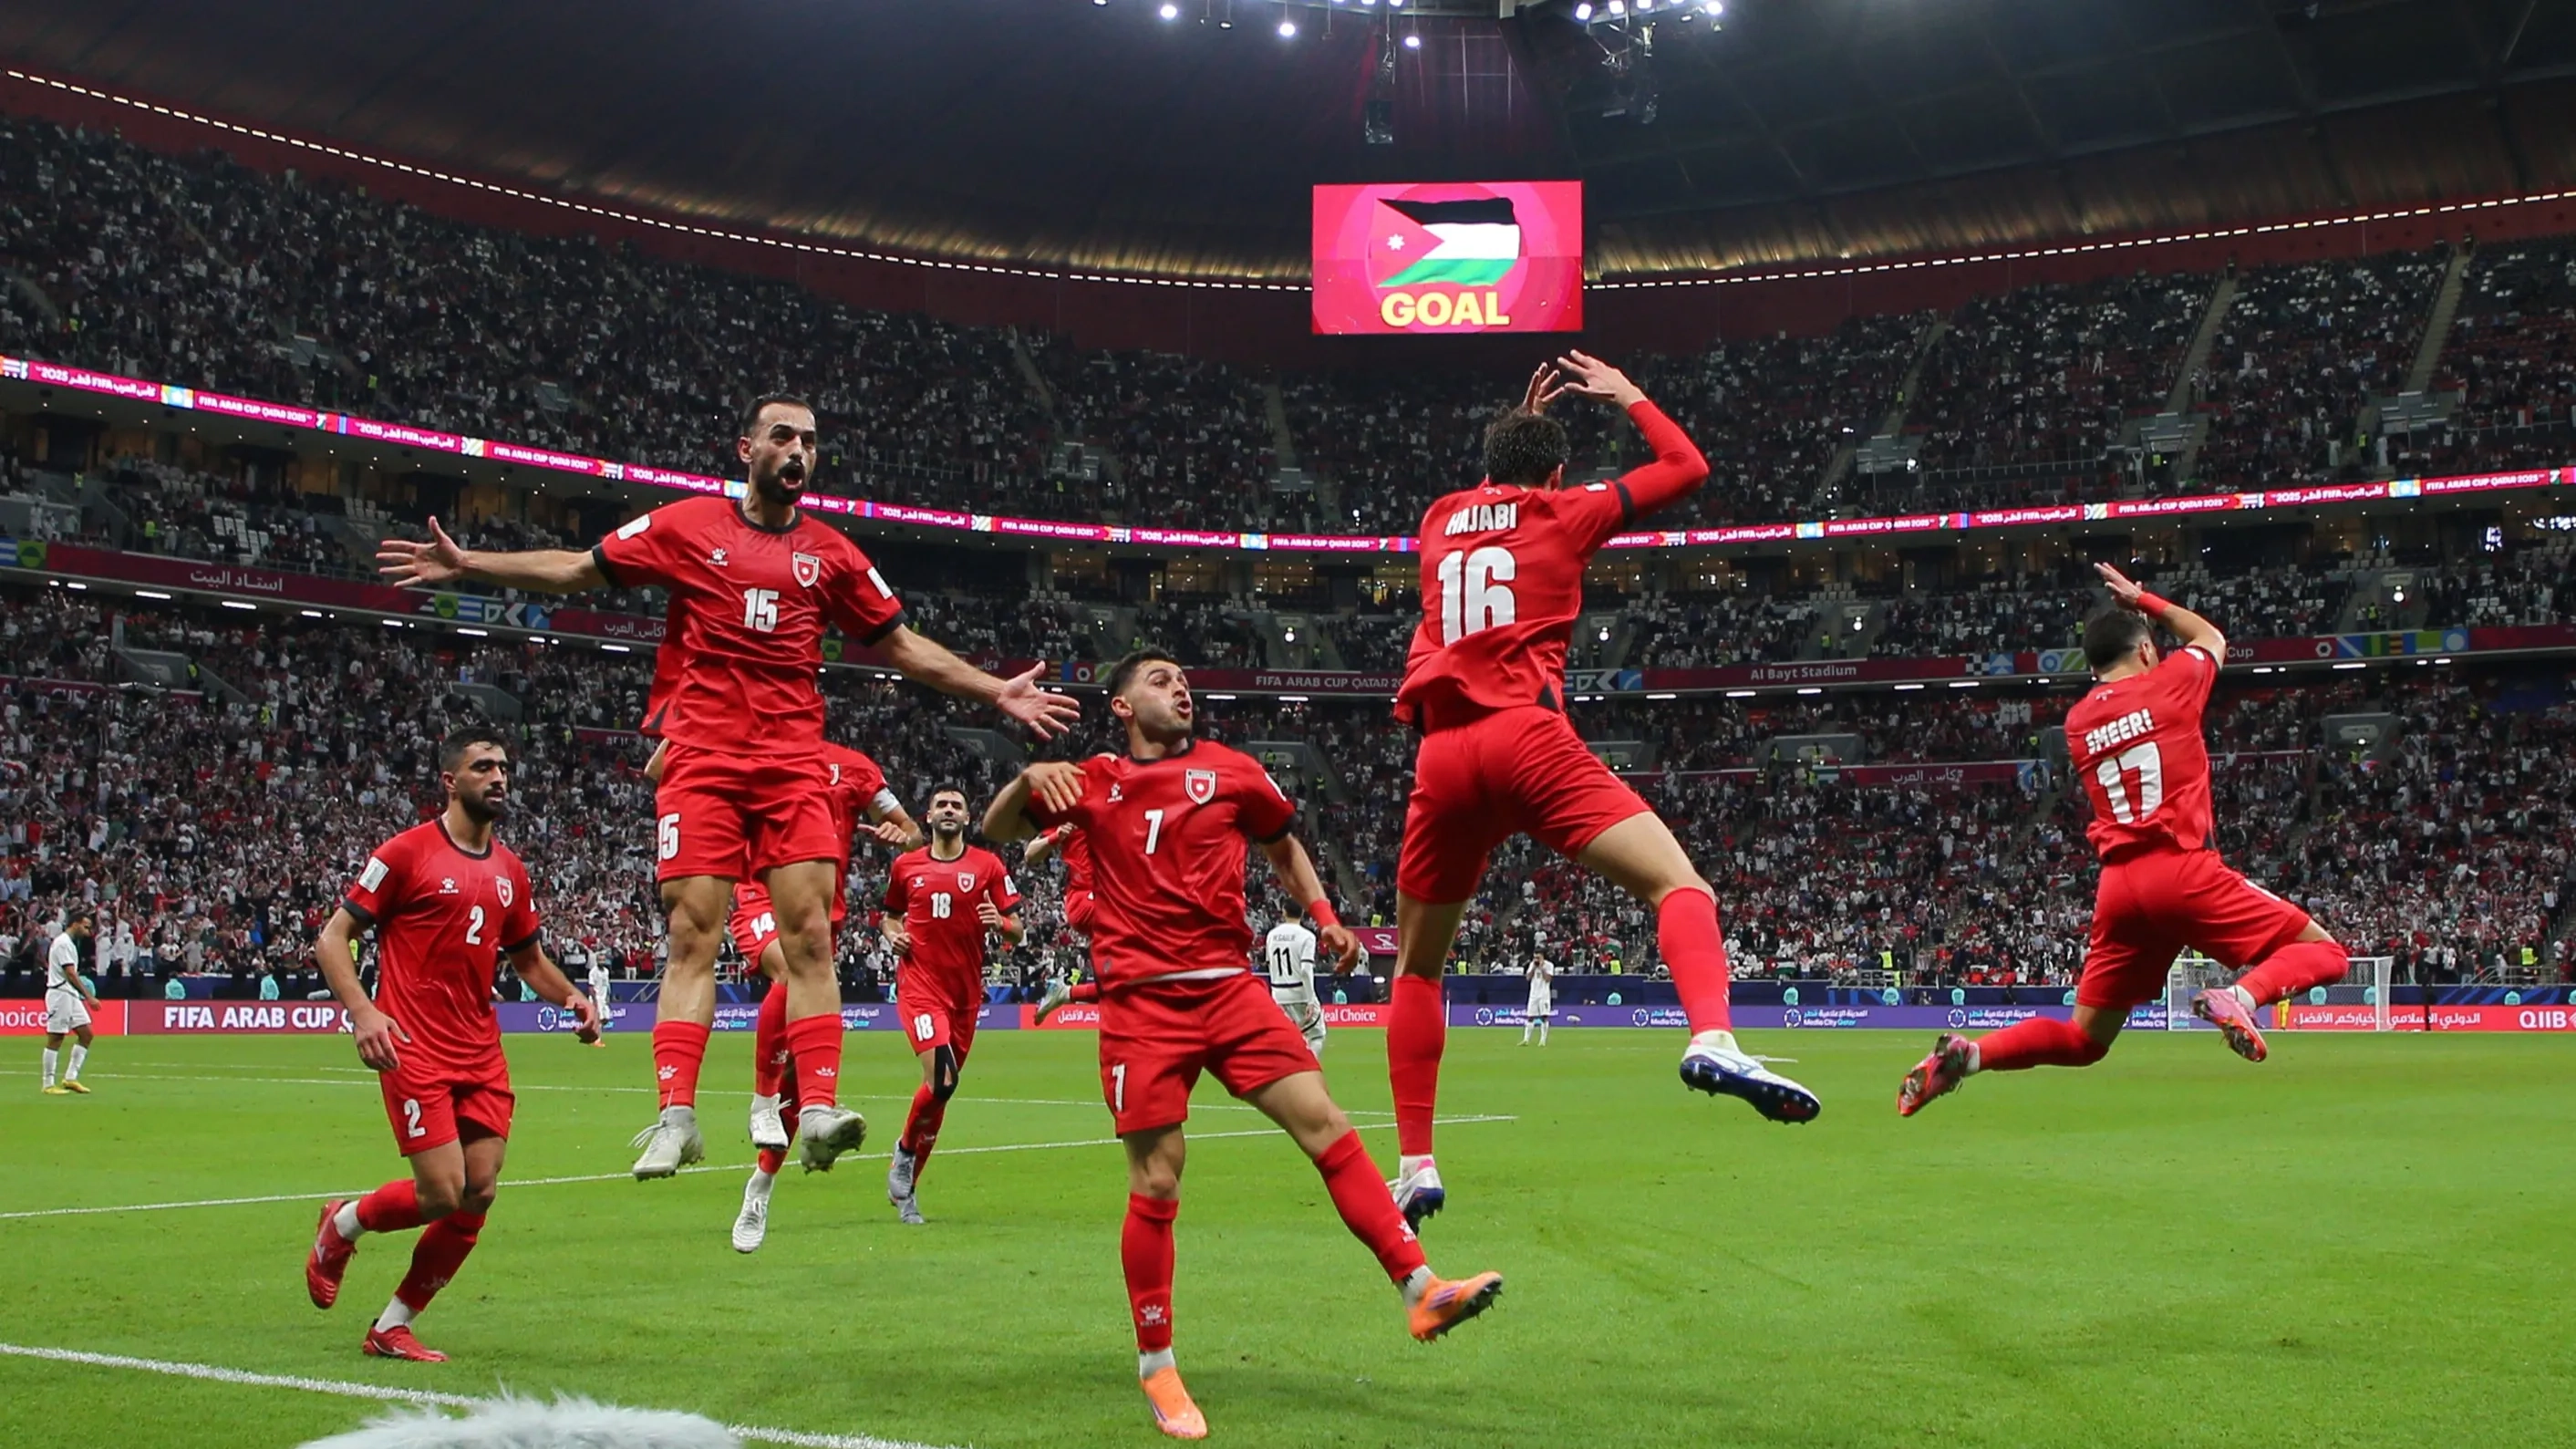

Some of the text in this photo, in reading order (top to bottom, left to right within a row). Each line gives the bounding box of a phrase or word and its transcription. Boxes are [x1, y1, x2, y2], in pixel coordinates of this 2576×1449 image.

[1381, 292, 1510, 327] GOAL
[90, 377, 113, 389] FIFA
[199, 397, 217, 407] FIFA
[219, 400, 243, 411] ARAB
[244, 404, 261, 413] CUP
[400, 431, 419, 441] FIFA
[493, 447, 511, 456] FIFA
[512, 450, 533, 460] ARAB
[533, 453, 548, 462] CUP
[670, 475, 688, 485] FIFA
[2447, 480, 2471, 488] ARAB
[2472, 478, 2489, 486] CUP
[2322, 490, 2342, 498] FIFA
[2162, 502, 2178, 510] CUP
[917, 512, 935, 521] FIFA
[1445, 502, 1517, 536] HAJABI
[2022, 512, 2041, 520] FIFA
[1737, 530, 1755, 538] FIFA
[1847, 523, 1867, 531] ARAB
[190, 571, 231, 588] البيت
[1437, 546, 1516, 648] 16
[743, 587, 780, 633] 15
[1750, 666, 1857, 682] Al Bayt Stadium
[1256, 676, 1282, 687] FIFA
[1286, 677, 1320, 688] ARAB
[1324, 678, 1348, 688] CUP
[1351, 678, 1389, 689] QATAR
[2085, 708, 2155, 755] SMEERI
[2095, 740, 2163, 825] 17
[1143, 809, 1164, 855] 7
[930, 892, 952, 919] 18
[465, 905, 485, 946] 2
[750, 912, 776, 941] 14
[1273, 947, 1293, 977] 11
[164, 1006, 215, 1029] FIFA
[221, 1006, 285, 1029] ARAB
[292, 1006, 336, 1029] CUP
[1340, 1009, 1377, 1022] Choice
[1824, 1019, 1837, 1028] City
[1990, 1019, 2003, 1028] City
[2439, 1012, 2480, 1028] الدولي
[2519, 1010, 2567, 1029] QIIB
[913, 1013, 936, 1042] 18
[403, 1098, 427, 1138] 2
